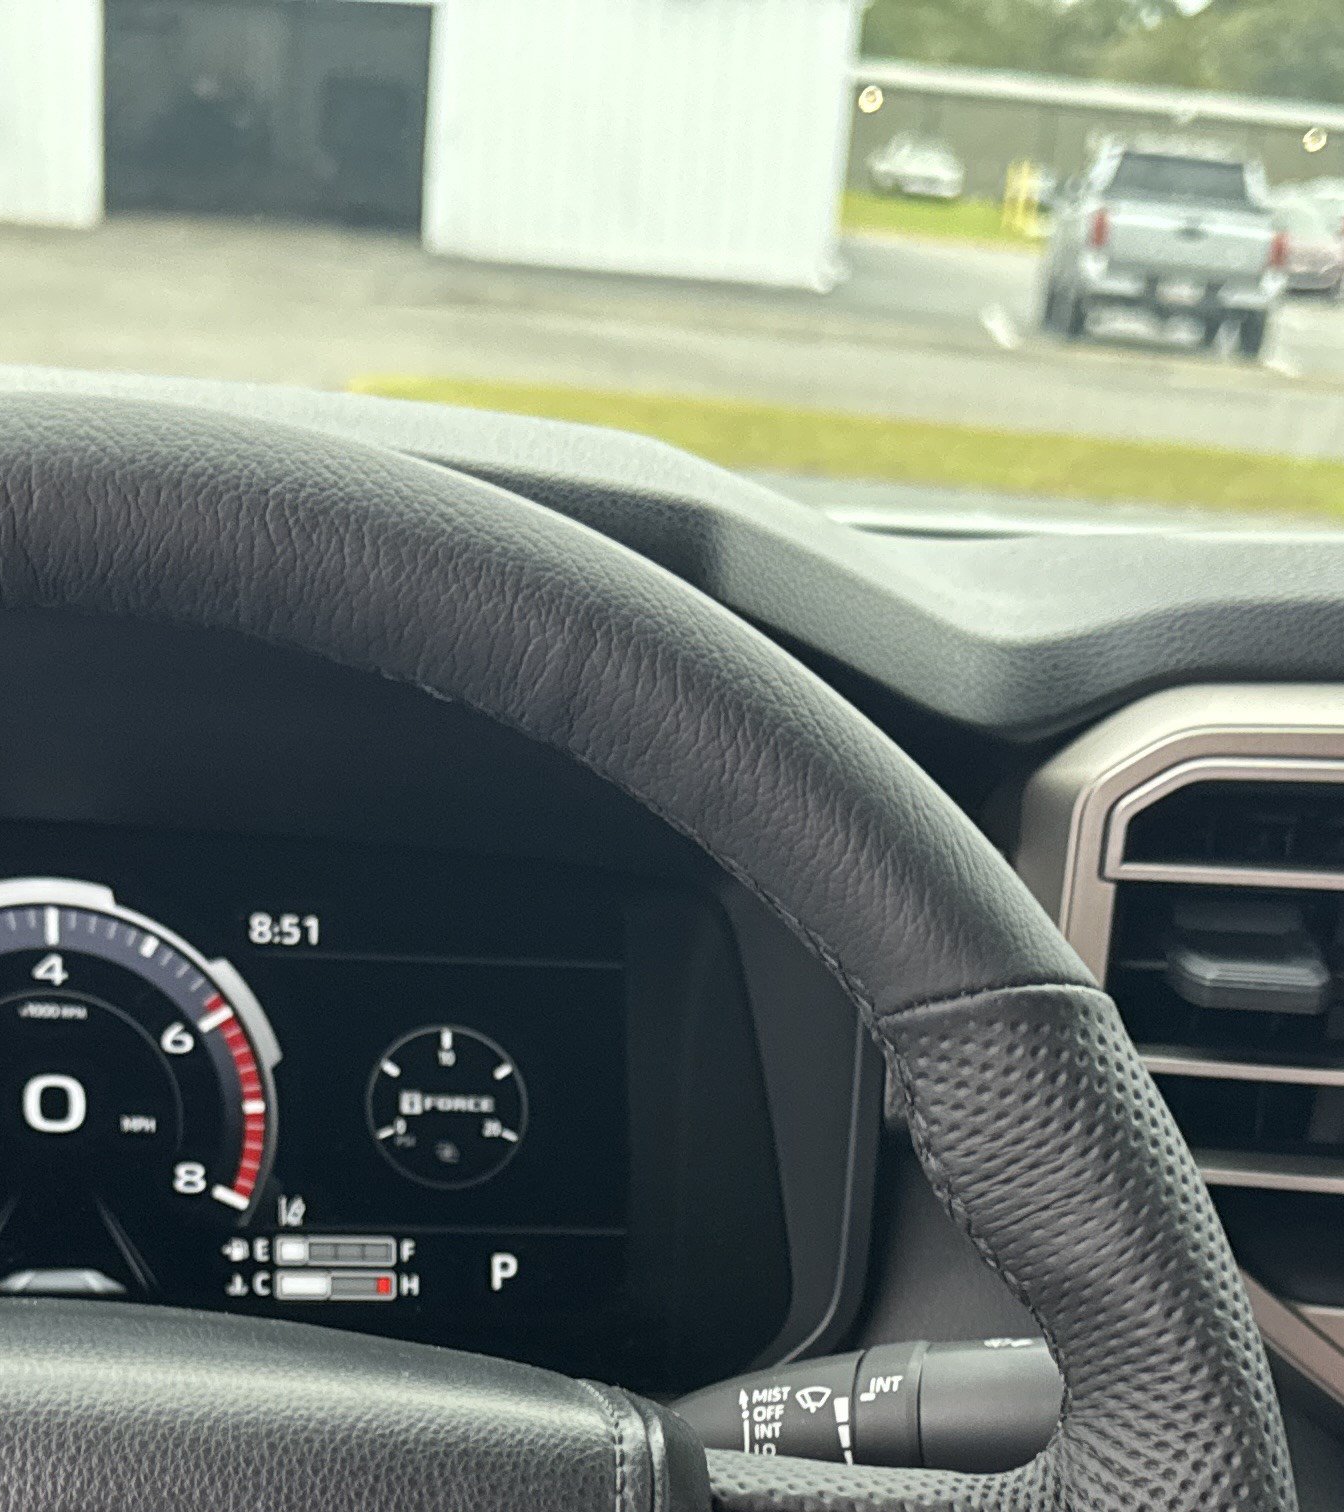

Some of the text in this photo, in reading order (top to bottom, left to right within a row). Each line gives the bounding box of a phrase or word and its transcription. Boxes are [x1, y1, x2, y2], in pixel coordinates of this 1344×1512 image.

[248, 912, 320, 946] 8:51
[31, 953, 69, 987] 4
[160, 1021, 195, 1055] 6
[22, 1072, 87, 1133] 0
[172, 1161, 207, 1195] 8
[254, 1239, 270, 1262] E
[401, 1239, 416, 1262] F
[490, 1252, 519, 1291] P
[253, 1273, 271, 1295] C
[401, 1274, 419, 1296] H
[752, 1386, 791, 1404] MIST
[869, 1375, 904, 1393] INT
[753, 1404, 785, 1422] OFF
[754, 1422, 782, 1439] INT
